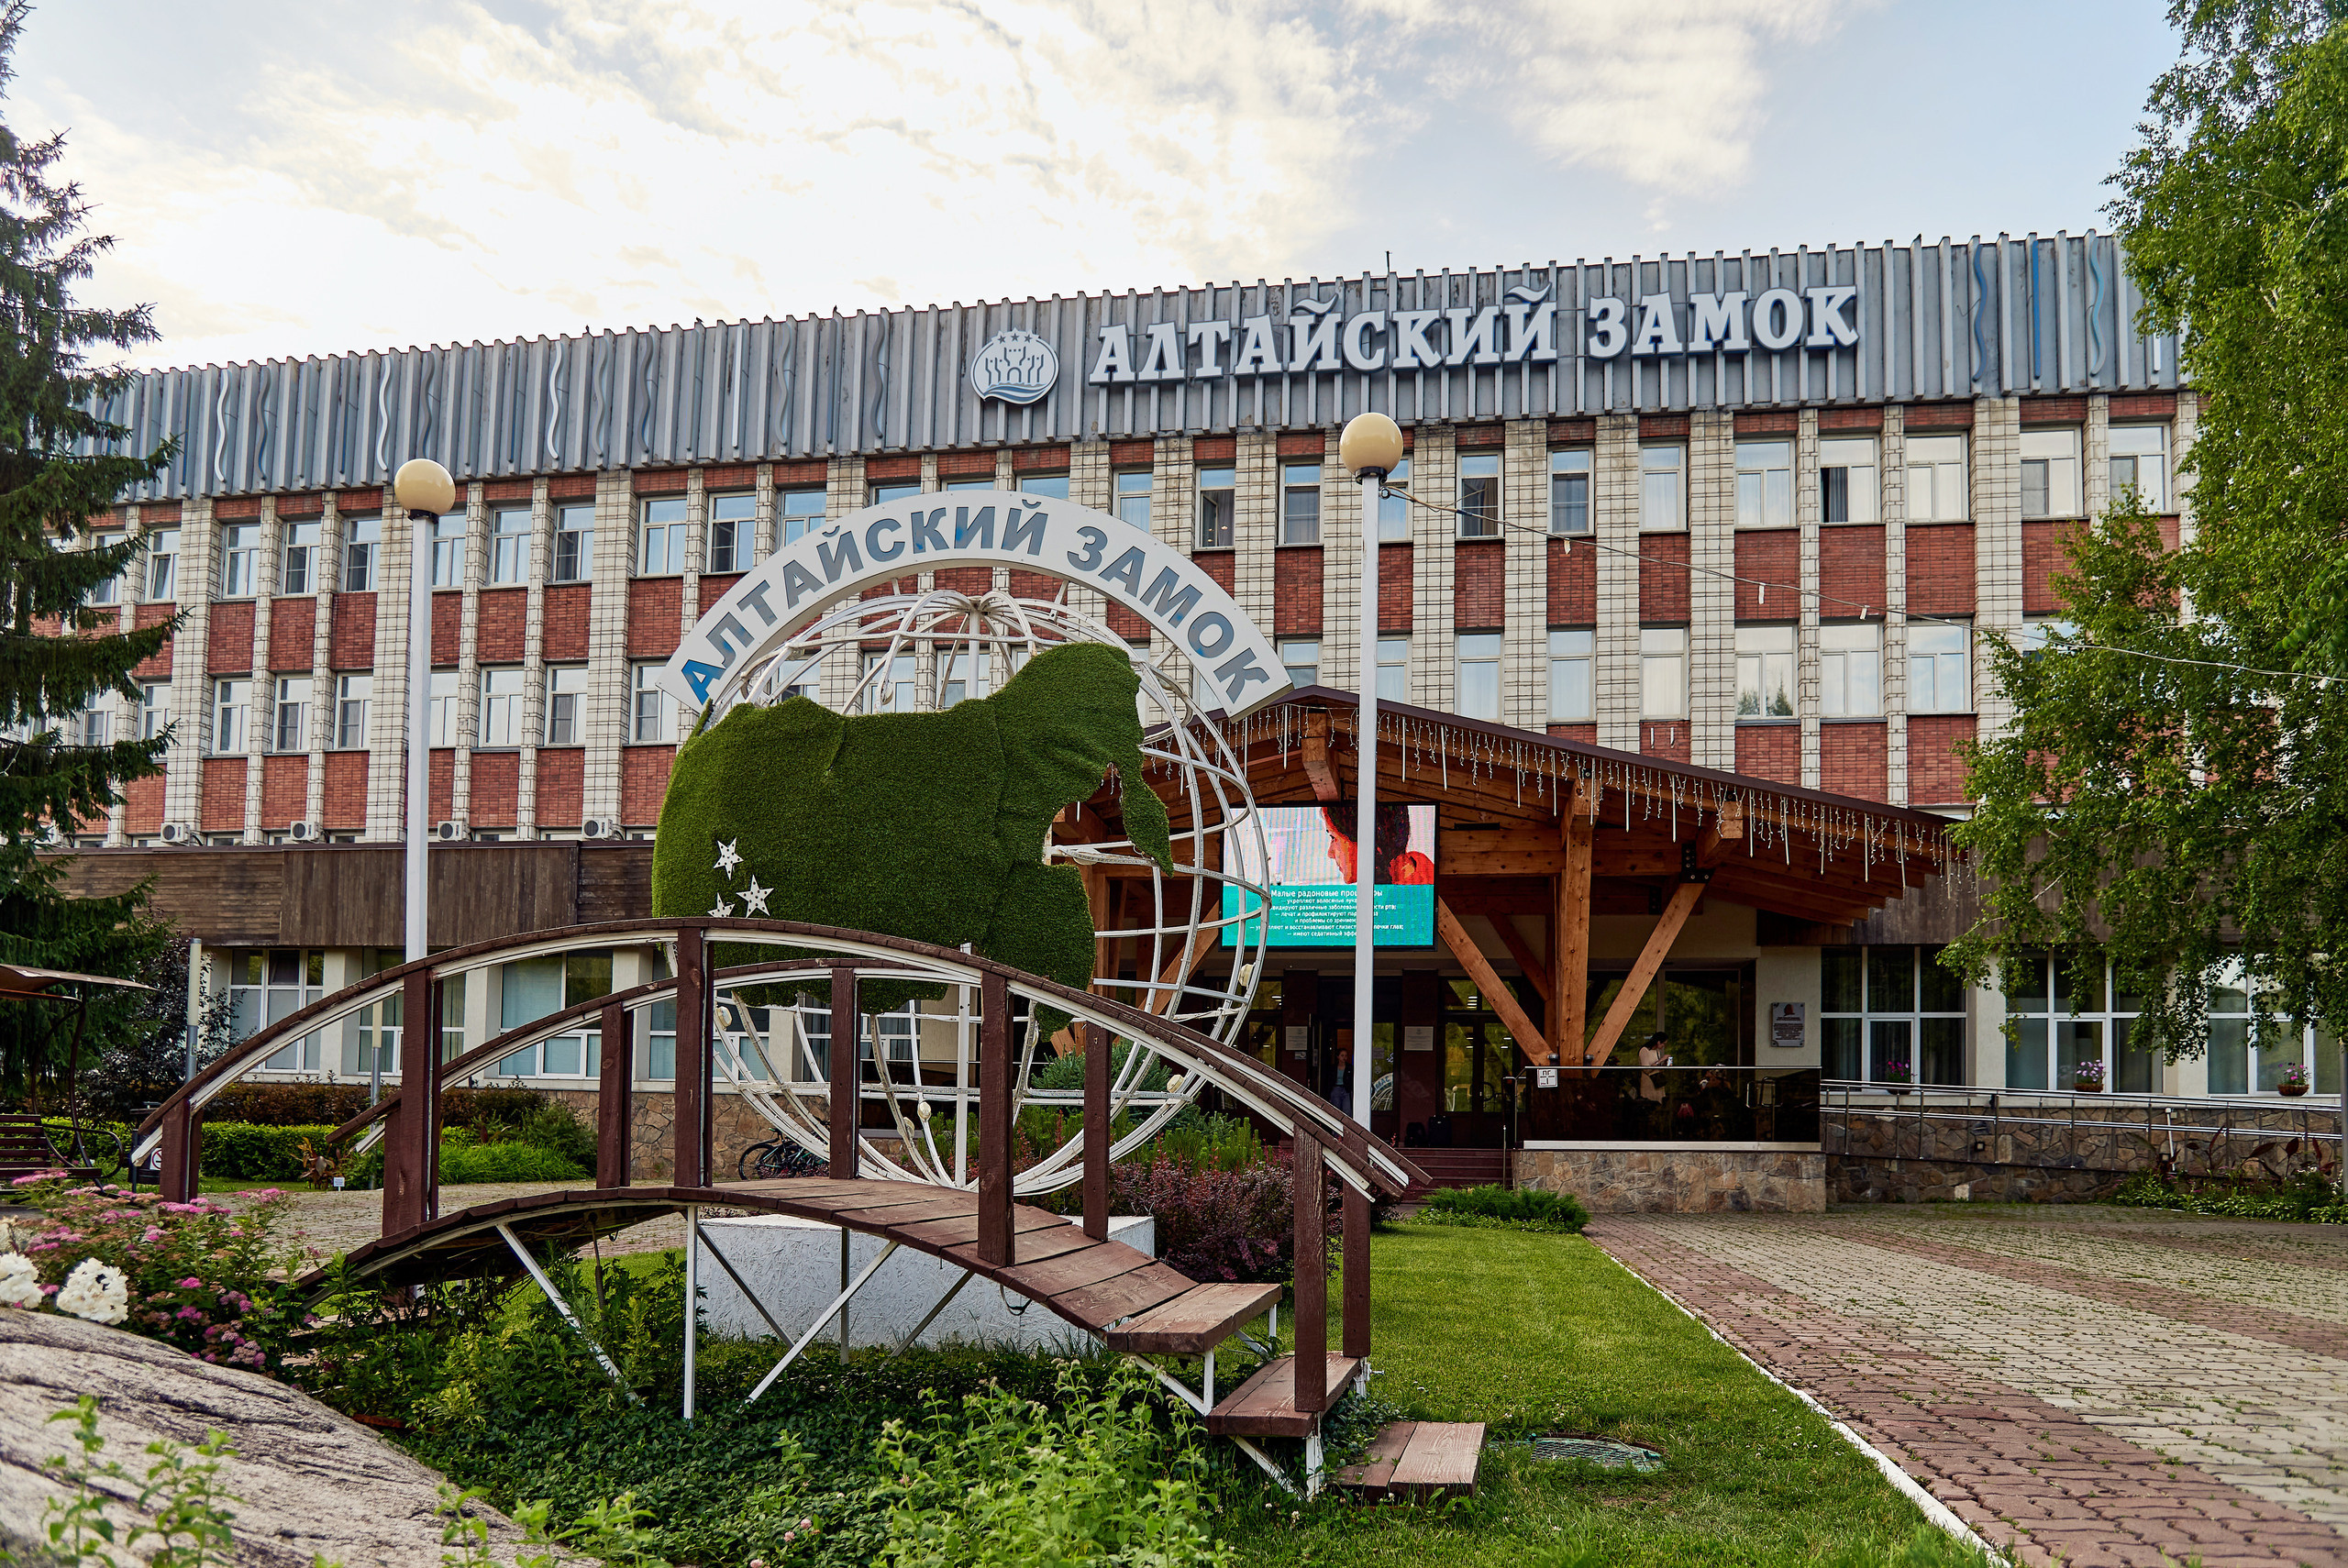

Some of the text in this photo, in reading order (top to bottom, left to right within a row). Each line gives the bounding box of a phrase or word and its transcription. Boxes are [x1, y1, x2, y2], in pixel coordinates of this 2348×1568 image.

[1089, 282, 1860, 385] АЛТАЙСКИЙ ЗАМОК
[681, 499, 1269, 704] АЛТАЙСКИЙ ЗАМОК
